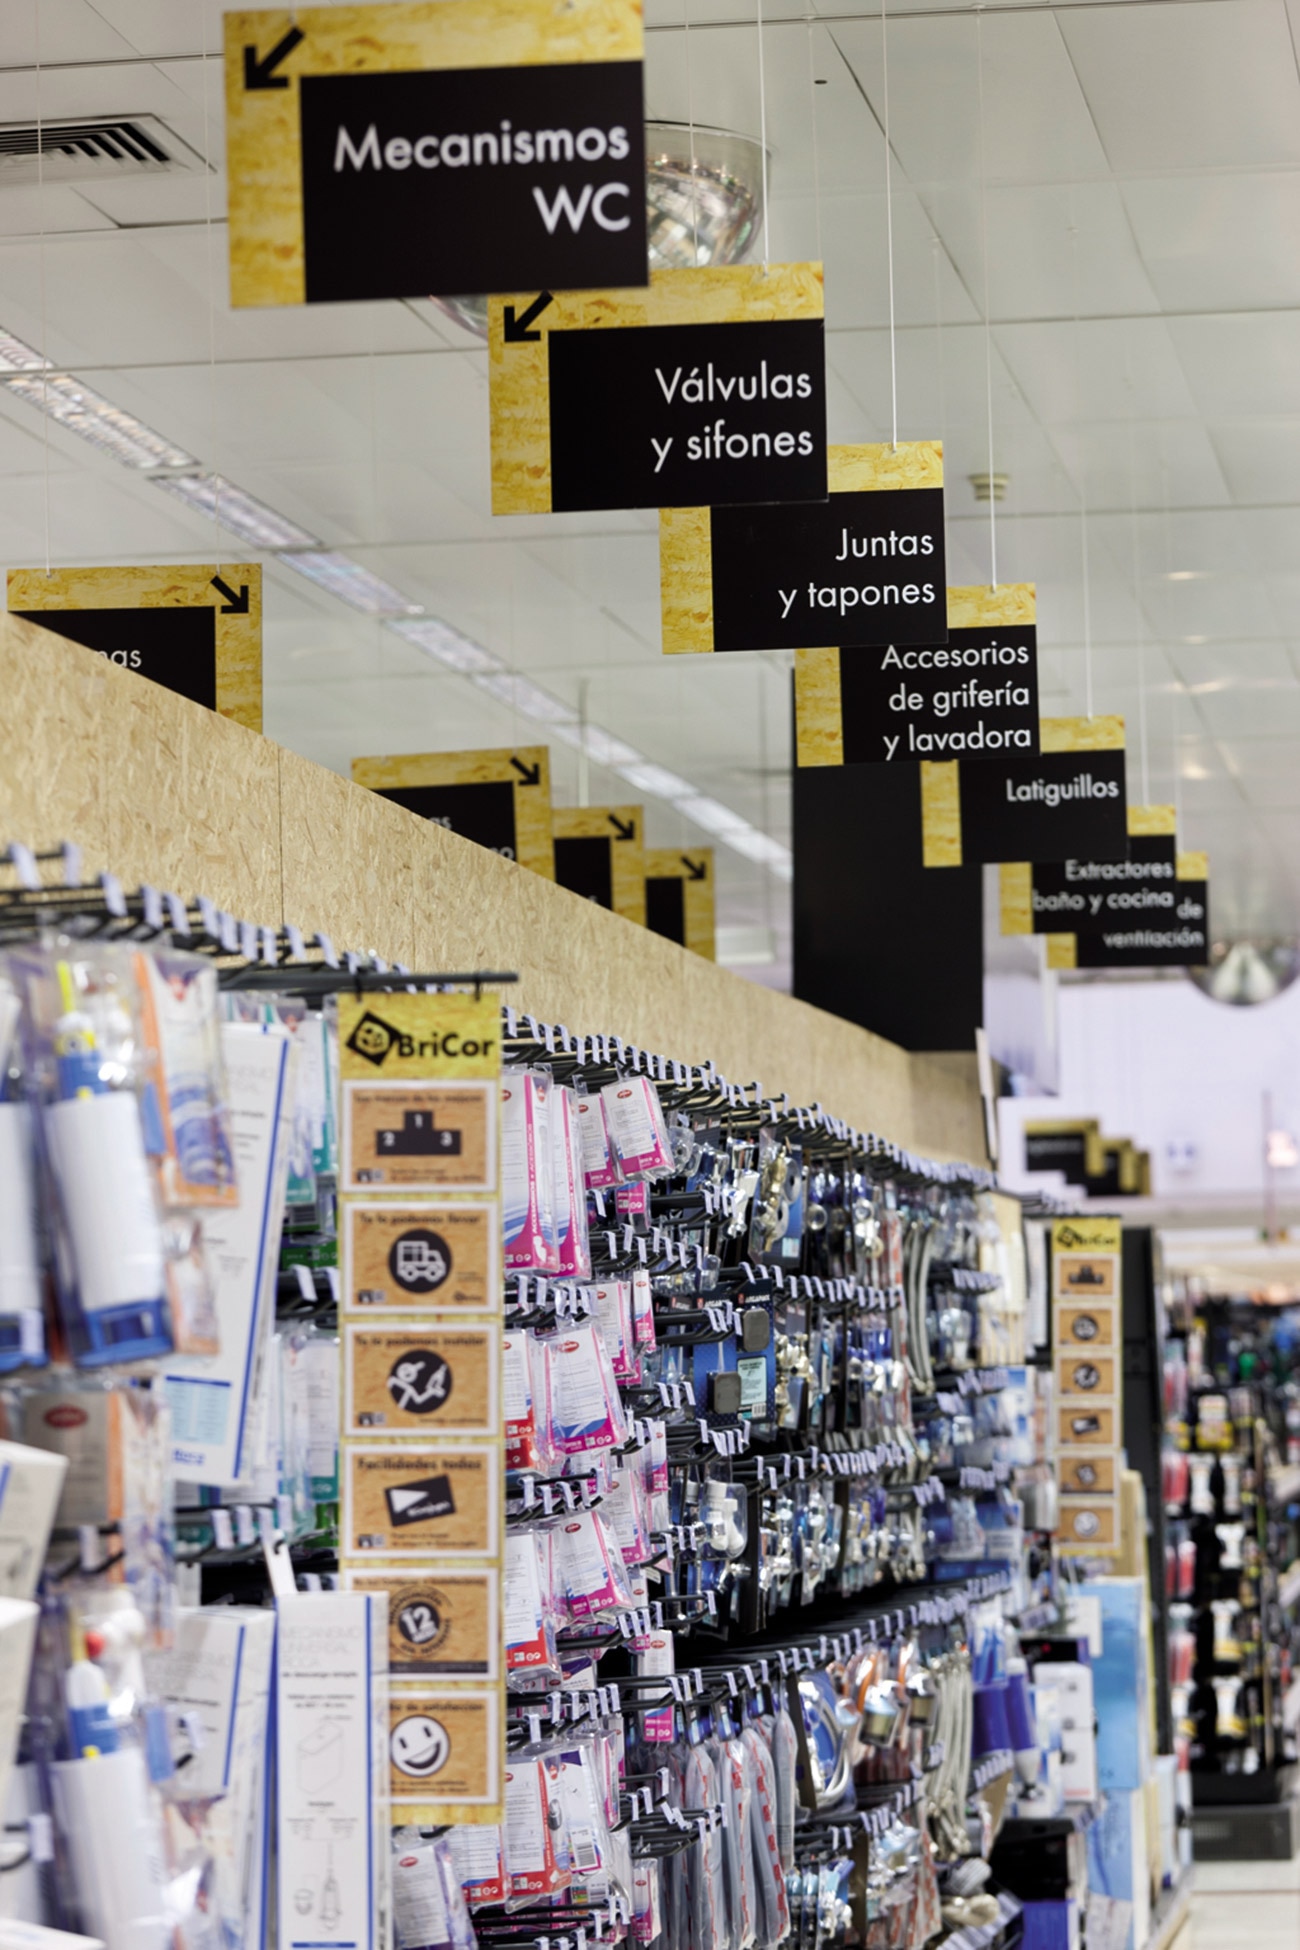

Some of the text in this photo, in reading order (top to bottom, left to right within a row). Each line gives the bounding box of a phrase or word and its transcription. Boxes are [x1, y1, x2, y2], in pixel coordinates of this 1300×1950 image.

[334, 120, 630, 172] Mecanismos
[532, 182, 631, 234] WC
[654, 359, 812, 404] Válvulas
[651, 418, 814, 473] y sifones
[835, 528, 934, 561] Juntas
[778, 582, 936, 619] y tapones
[880, 641, 1030, 670] Accesorios
[888, 678, 1030, 717] de grifería
[882, 720, 1032, 761] y lavadora
[1006, 773, 1120, 807] Latiguillos
[1065, 859, 1174, 881] Extractores
[1088, 894, 1103, 915] y
[1106, 887, 1174, 910] cocina
[1176, 896, 1204, 920] de
[1102, 926, 1205, 948] ventilación
[397, 1031, 495, 1058] BriCor
[401, 1605, 435, 1635] 12
